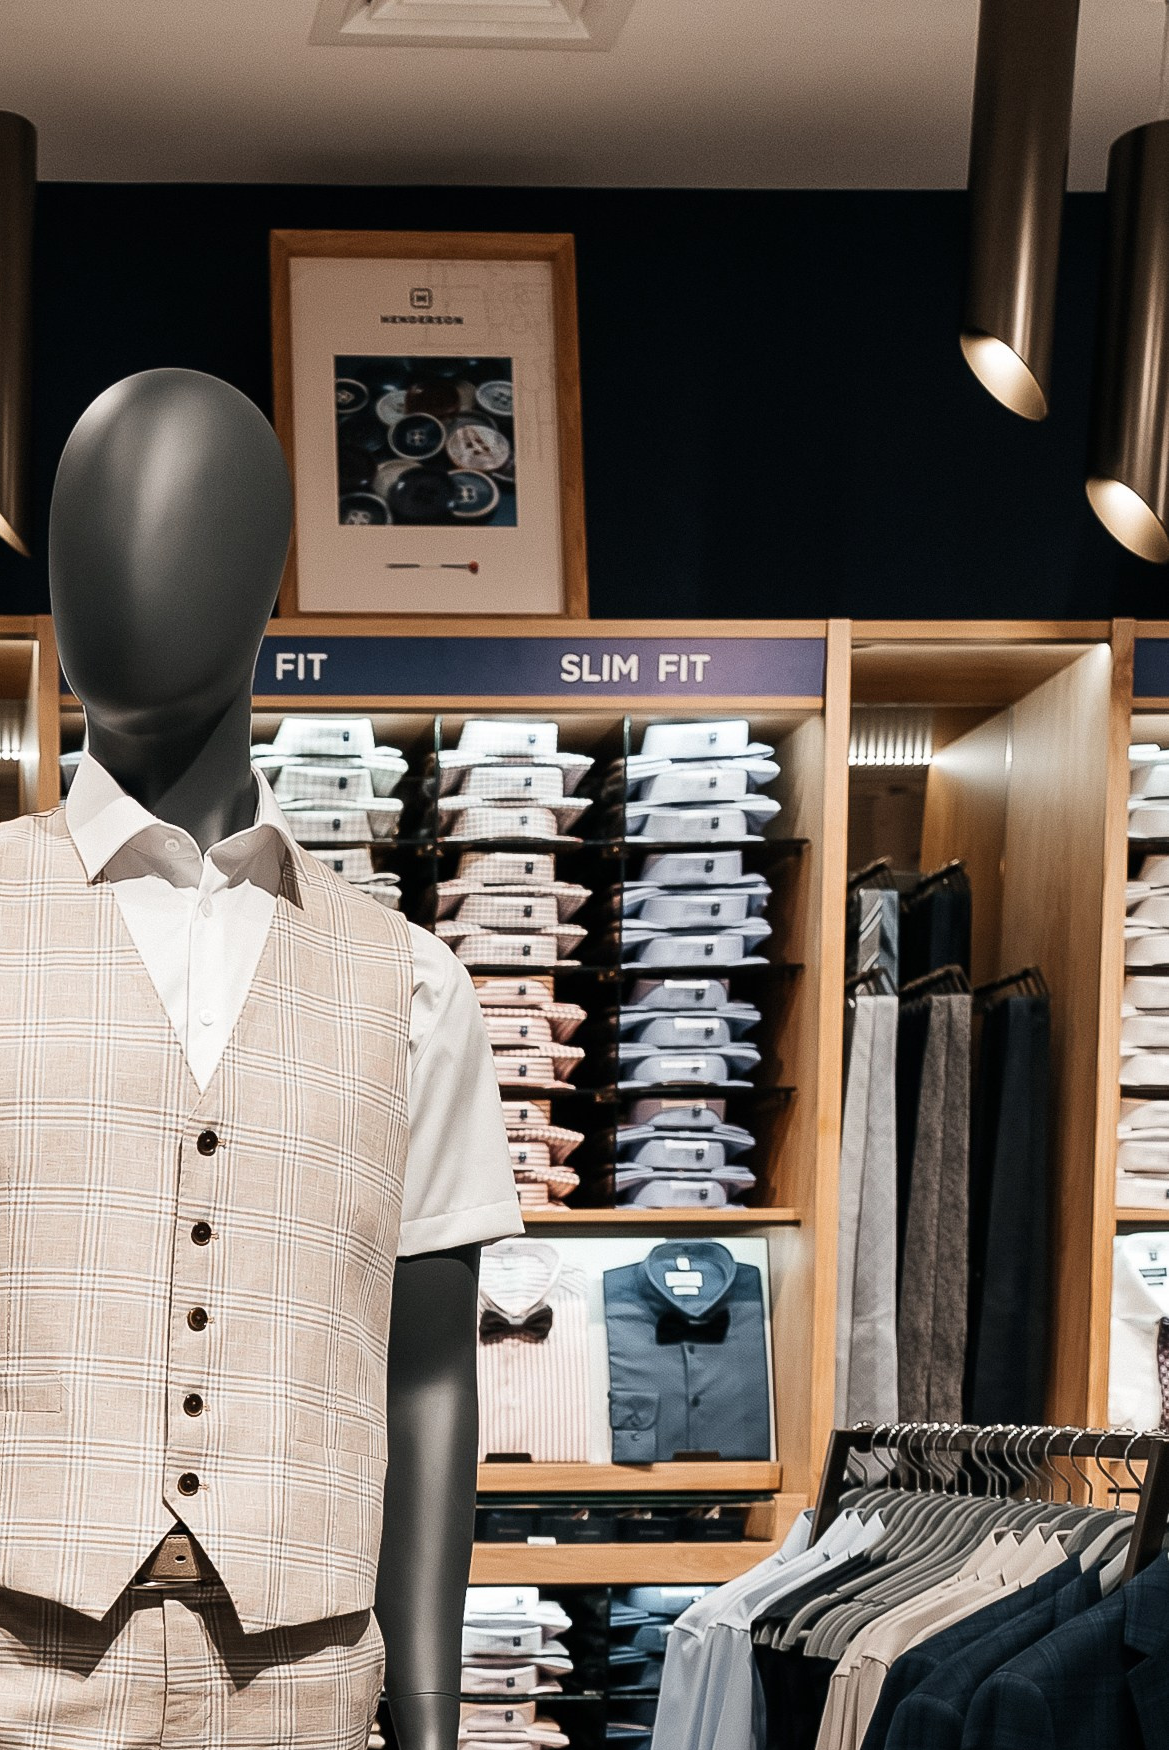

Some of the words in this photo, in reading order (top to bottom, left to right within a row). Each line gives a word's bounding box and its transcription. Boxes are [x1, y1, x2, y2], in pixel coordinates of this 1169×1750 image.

[380, 315, 464, 325] HENDERSON
[276, 653, 328, 681] FIT
[560, 653, 639, 683] SLIM
[658, 653, 711, 683] FIT
